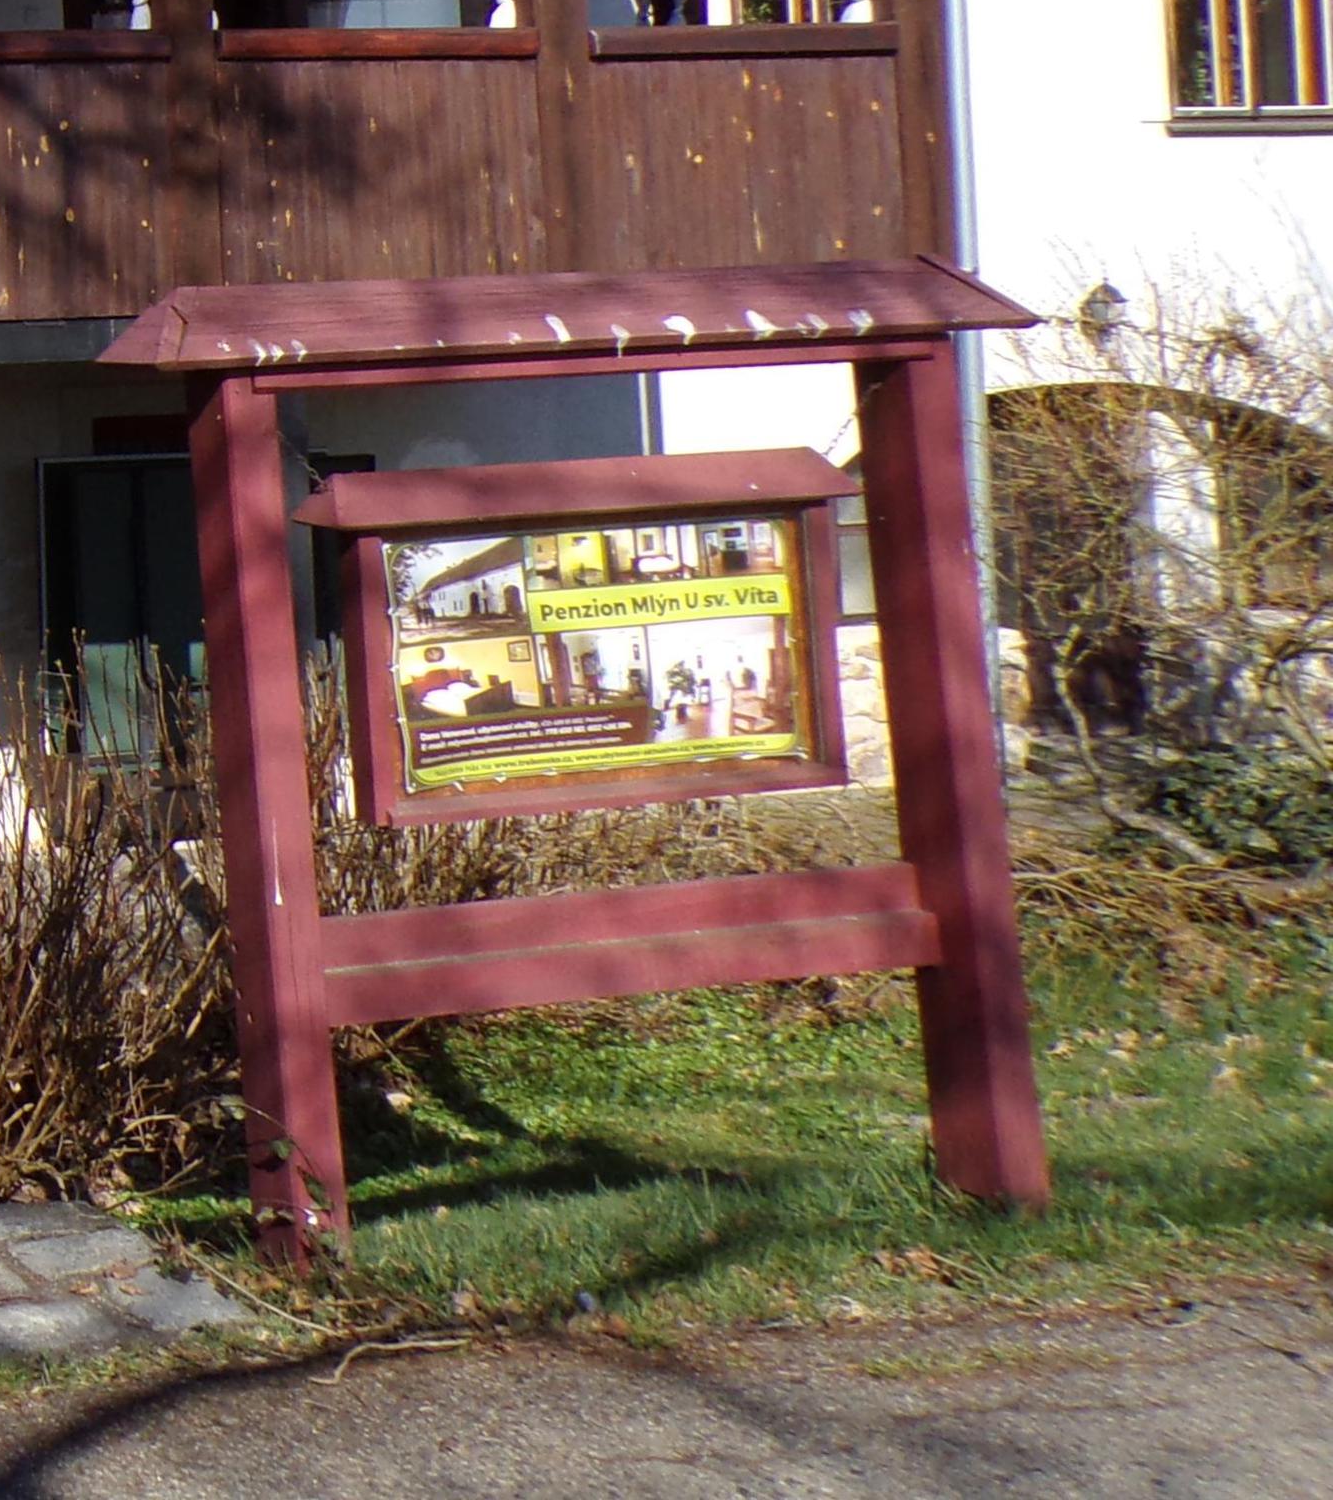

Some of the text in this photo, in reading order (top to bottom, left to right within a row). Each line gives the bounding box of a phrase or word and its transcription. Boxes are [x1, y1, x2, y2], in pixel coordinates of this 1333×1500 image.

[540, 586, 779, 621] Penzion Mlýn U sv. Víta
